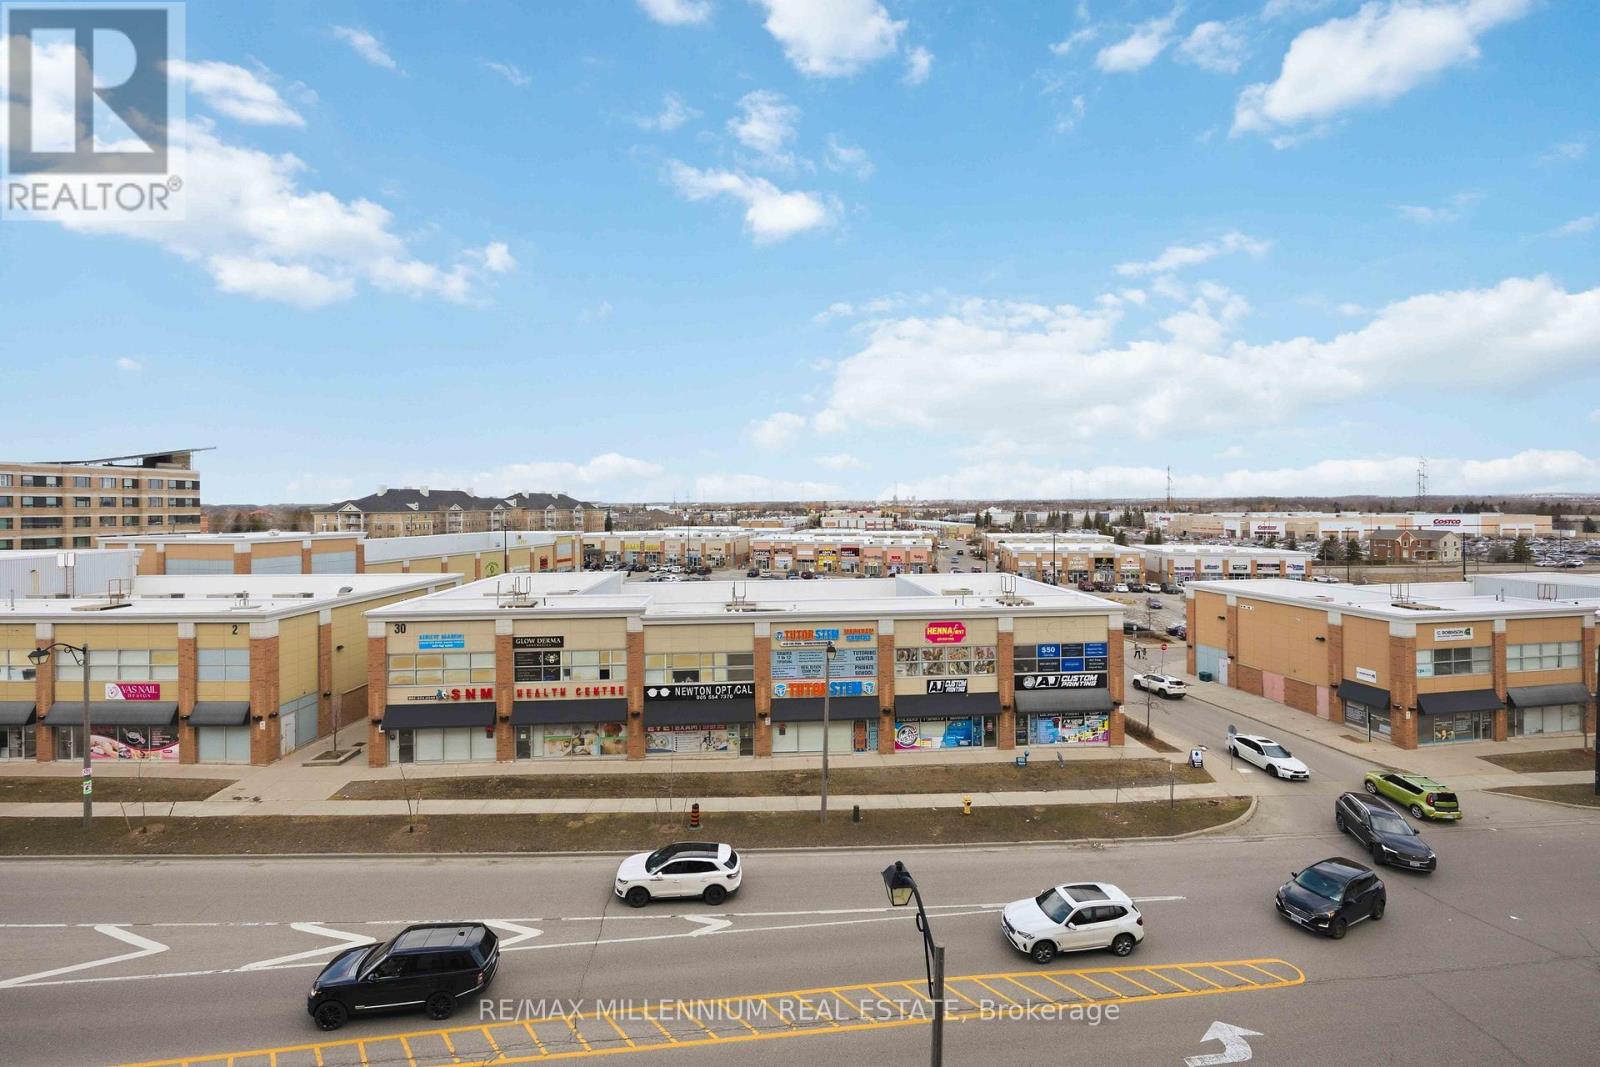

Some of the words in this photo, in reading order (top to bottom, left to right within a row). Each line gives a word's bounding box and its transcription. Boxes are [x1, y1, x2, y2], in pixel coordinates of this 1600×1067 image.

[232, 624, 239, 635] 2
[394, 623, 406, 634] 30
[816, 629, 839, 640] STEM
[138, 685, 157, 693] NAIL
[517, 688, 566, 698] HEALTH
[576, 686, 624, 696] CENTRE
[675, 686, 711, 696] NEWTON
[829, 681, 862, 696] STEM
